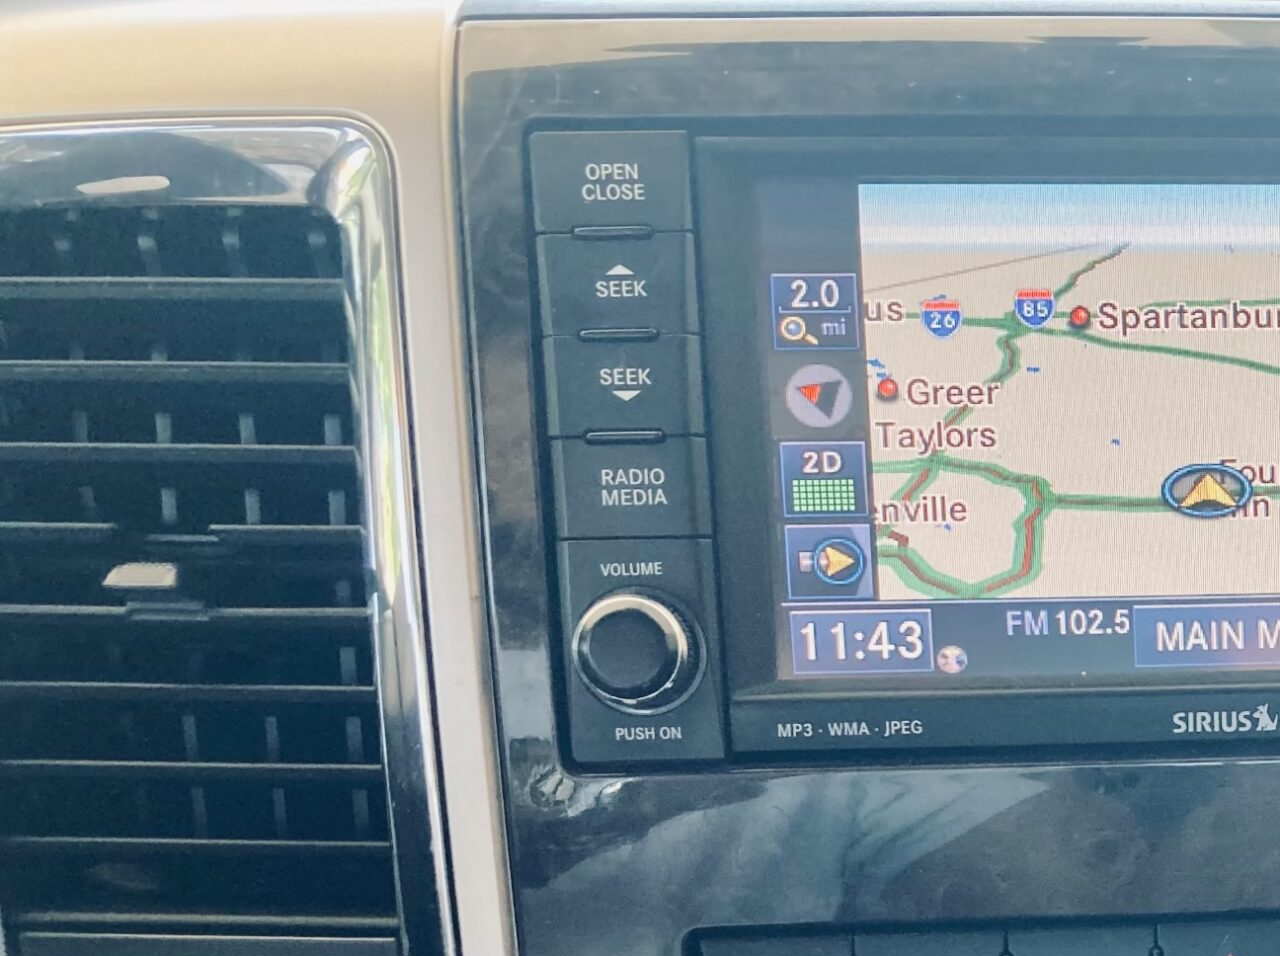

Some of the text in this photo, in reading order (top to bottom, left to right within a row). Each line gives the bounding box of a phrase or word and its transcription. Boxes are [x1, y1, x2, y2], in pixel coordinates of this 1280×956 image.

[585, 163, 639, 181] OPEN
[581, 183, 646, 202] CLOSE
[595, 281, 648, 298] SEEK
[790, 279, 841, 309] 2.0
[1022, 303, 1049, 318] 85
[822, 317, 846, 336] mi
[929, 313, 956, 329] 26
[600, 368, 651, 385] SEEK
[907, 379, 1000, 406] Greer
[875, 421, 997, 454] Taylors
[803, 451, 842, 474] 2D
[601, 468, 665, 486] RADIO
[601, 488, 668, 506] MEDIA
[600, 562, 663, 577] VOLUME
[1007, 609, 1131, 637] FM 102.5
[800, 621, 926, 661] 11:43
[1155, 620, 1245, 652] MAIN
[777, 720, 923, 738] MP3 WMA JPEG
[1172, 710, 1252, 734] SIRIUS
[615, 726, 682, 741] PUSH ON
